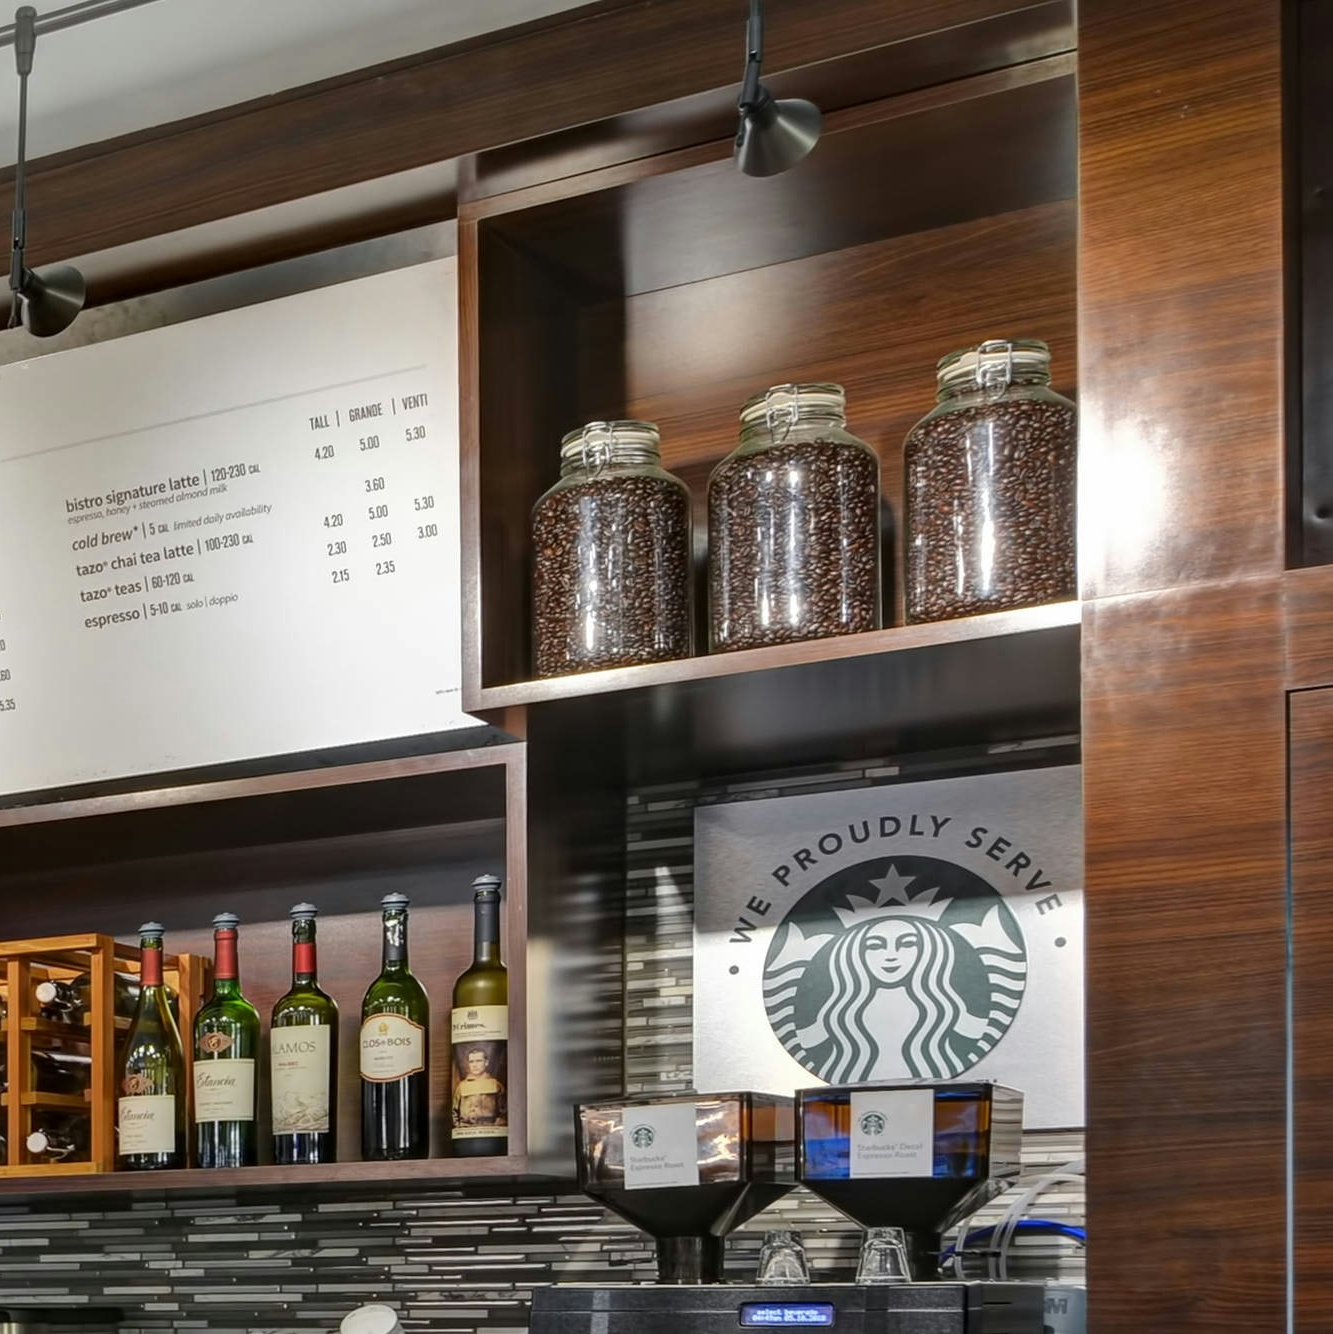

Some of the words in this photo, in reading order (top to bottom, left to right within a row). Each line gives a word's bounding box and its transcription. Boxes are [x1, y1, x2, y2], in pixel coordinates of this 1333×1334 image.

[308, 414, 330, 430] TALL
[348, 402, 382, 422] GRANDE
[400, 392, 428, 410] VENTI
[313, 444, 335, 460] 4.20
[358, 434, 380, 452] 5.00
[404, 424, 426, 442] 5.30
[65, 495, 103, 513] bistro
[105, 482, 166, 506] signature
[167, 475, 200, 491] latte
[210, 462, 246, 482] 120-230
[174, 486, 208, 503] almond
[208, 482, 228, 495] milk
[364, 476, 385, 493] 3.60
[71, 532, 98, 551] cold
[148, 521, 156, 536] 5
[202, 512, 224, 525] daily
[224, 503, 272, 521] availability
[322, 512, 344, 528] 4.20
[367, 503, 389, 520] 5.00
[413, 494, 435, 511] 5.30
[110, 551, 137, 570] chai
[138, 551, 161, 565] tea
[162, 544, 194, 560] latte
[204, 532, 240, 552] 100-230
[326, 540, 347, 557] 2.30
[371, 531, 392, 548] 2.50
[416, 522, 438, 539] 3.00
[113, 581, 142, 596] teas
[150, 571, 181, 589] 60-120
[330, 567, 350, 584] 2.15
[374, 559, 396, 576] 2.35
[83, 609, 140, 629] espresso
[148, 600, 169, 617] 5-10
[185, 598, 204, 610] solo
[728, 894, 773, 945] WE
[771, 813, 953, 889] PROUDLY
[964, 826, 1064, 917] SERVE
[386, 1036, 413, 1048] BOIS
